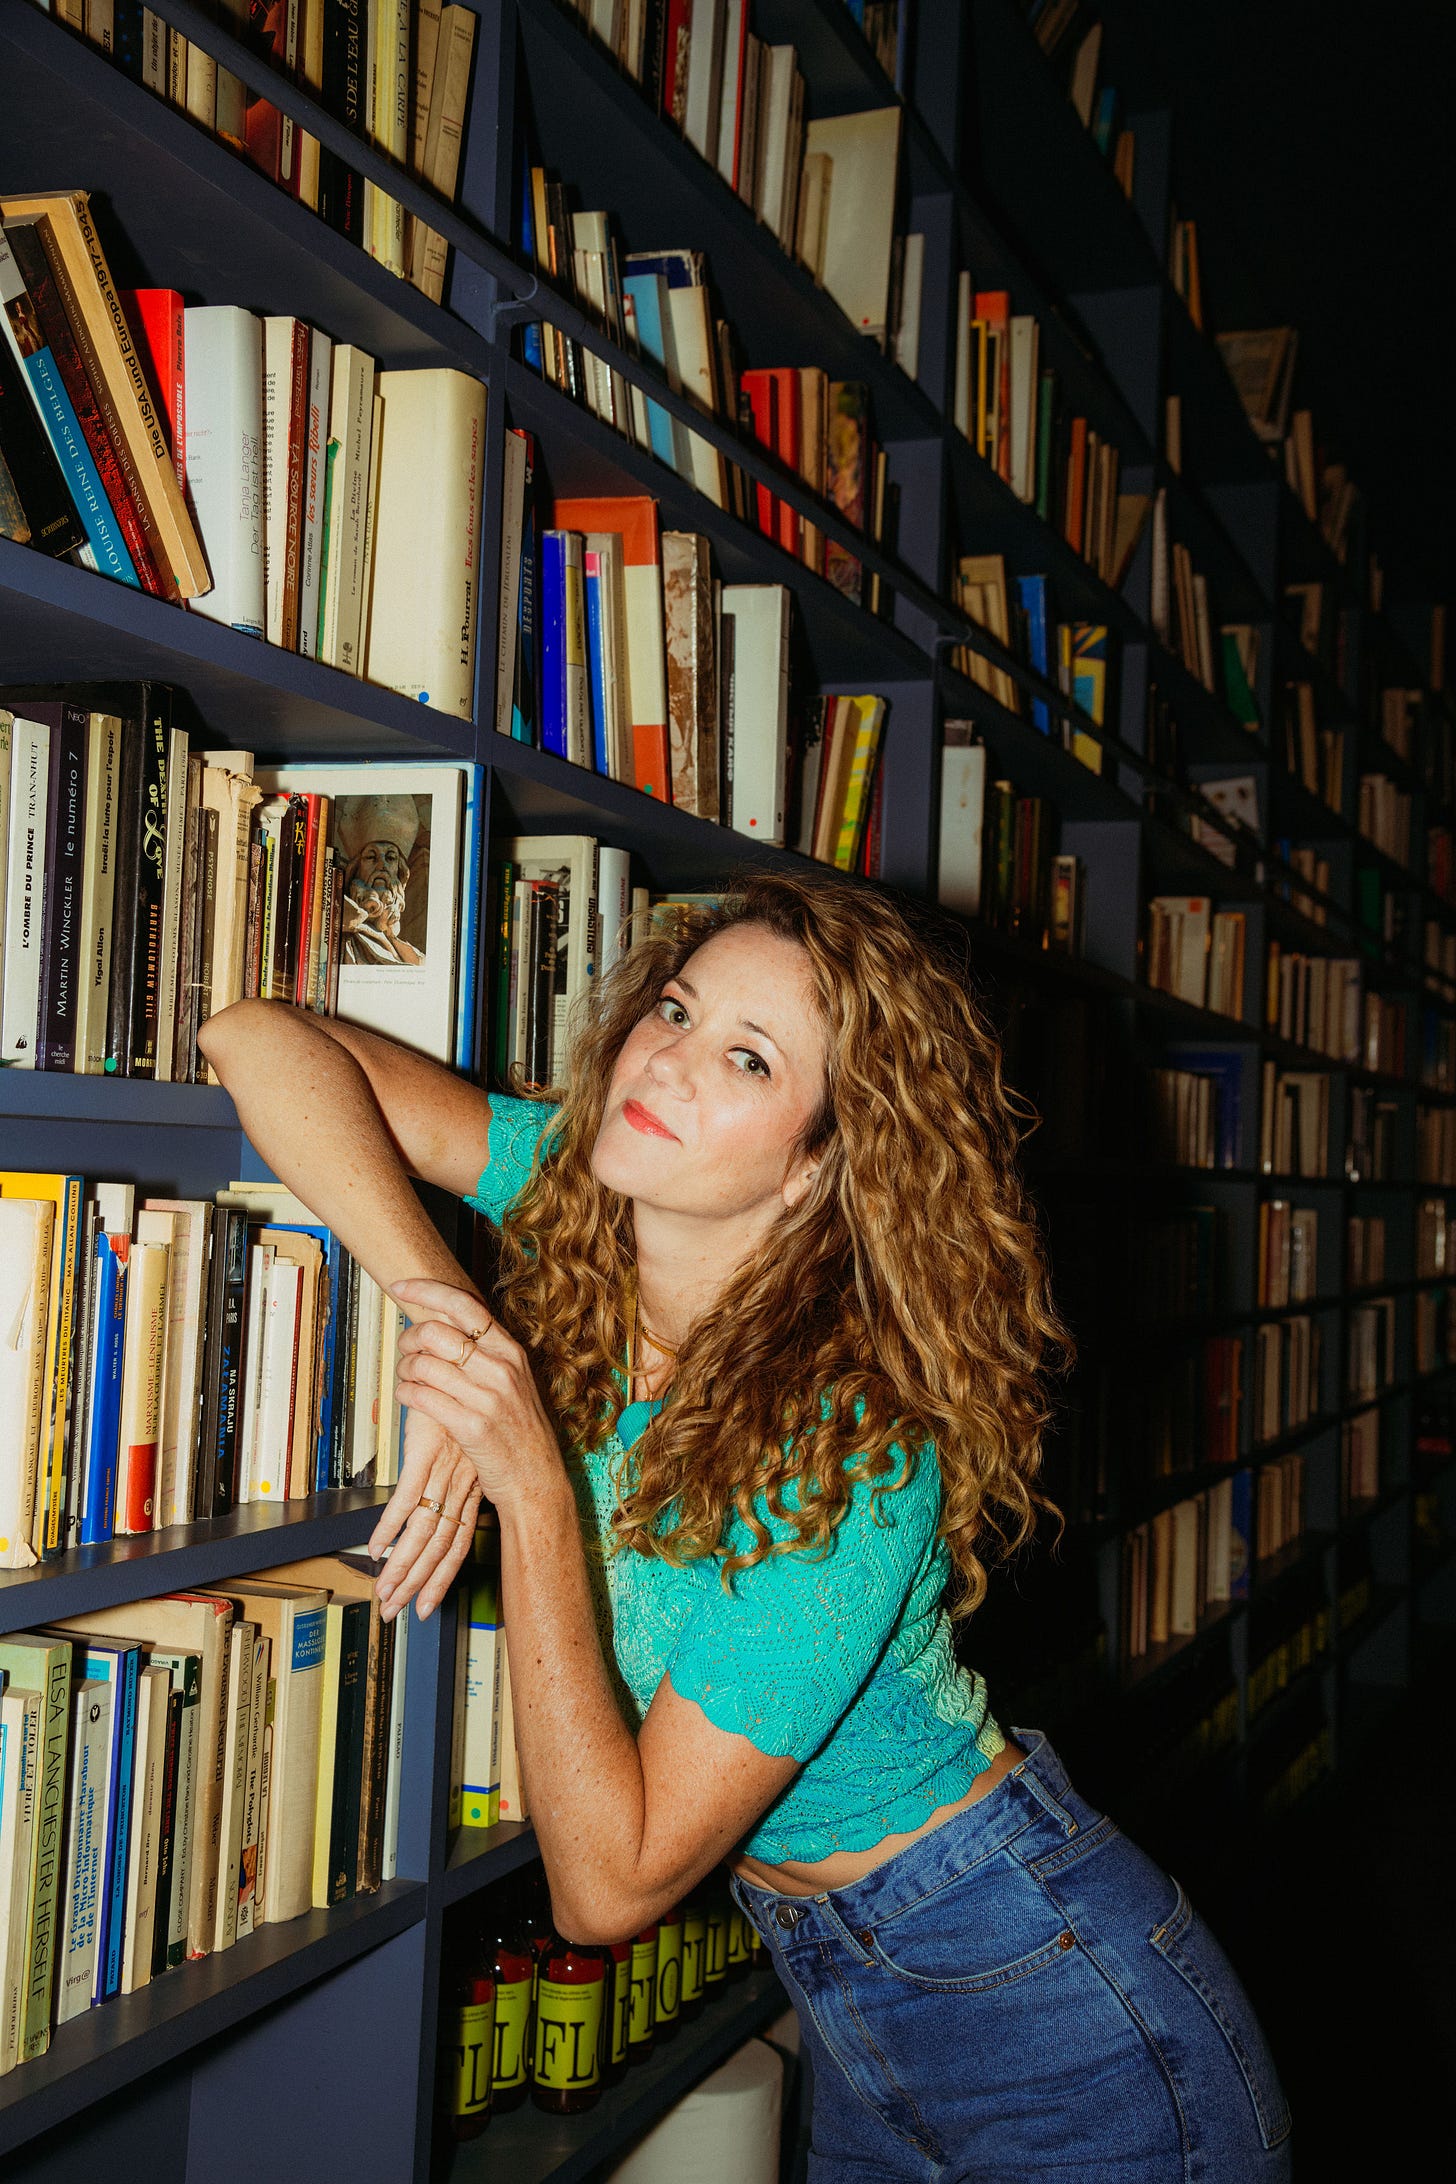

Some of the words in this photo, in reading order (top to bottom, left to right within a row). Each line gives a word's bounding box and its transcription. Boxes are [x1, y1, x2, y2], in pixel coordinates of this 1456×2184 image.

[346, 77, 358, 104] DE
[396, 73, 408, 129] CARPE
[75, 201, 110, 291] 1917-1945
[104, 290, 132, 354] Europa
[125, 354, 145, 389] und
[175, 340, 183, 372] Pierre
[36, 357, 65, 422] BELGES
[138, 388, 156, 430] USA
[61, 425, 80, 459] DES
[151, 430, 165, 459] Die
[241, 430, 251, 480] Langer
[290, 443, 300, 464] LA
[355, 429, 363, 462] Michel
[469, 417, 480, 459] sages
[119, 449, 131, 471] DES
[468, 464, 476, 484] les
[74, 460, 100, 513] REINE
[126, 476, 146, 514] DANSE
[240, 485, 250, 521] Tanja
[288, 468, 301, 535] SOURCE
[468, 486, 476, 501] et
[141, 515, 150, 532] LA
[251, 491, 264, 521] Tag
[94, 513, 123, 574] LOUISE
[251, 528, 261, 555] Der
[286, 537, 298, 593] NOIRE
[461, 580, 472, 643] Pourrat
[460, 648, 470, 667] H.
[104, 730, 114, 771] l'espoir
[153, 717, 165, 752] THE
[69, 751, 79, 761] 7
[28, 742, 40, 819] TRAN-NHUT
[105, 774, 113, 801] pour
[149, 784, 159, 807] OF
[157, 760, 168, 815] DEATH
[65, 769, 79, 835] numéro
[26, 828, 37, 870] PRINCE
[64, 843, 75, 857] le
[25, 874, 35, 891] DU
[206, 850, 215, 901] PSYCHOSE
[21, 896, 34, 949] L'OMBRE
[95, 927, 106, 957] Allon
[147, 904, 160, 988] BARTHOLOMEW
[94, 959, 105, 987] Yigal
[203, 961, 211, 997] ROBERT
[145, 994, 156, 1019] GILL
[69, 1183, 78, 1222] COLLINS
[68, 1224, 76, 1254] ALLAN
[65, 1256, 74, 1278] MAX
[63, 1288, 72, 1323] TITANIC
[62, 1325, 70, 1339] DU
[156, 1334, 163, 1347] ET
[34, 1351, 42, 1371] AUX
[60, 1340, 68, 1386] MEURTRES
[154, 1352, 162, 1394] GUERRE
[229, 1369, 237, 1386] NA
[58, 1388, 66, 1403] LES
[145, 1376, 155, 1435] MARXISME
[153, 1396, 160, 1410] LA
[226, 1389, 236, 1433] SKRAJU
[223, 1616, 232, 1648] The
[49, 1662, 68, 1724] ELSA
[219, 1652, 230, 1715] Evasive
[254, 1672, 263, 1710] William
[28, 1710, 38, 1755] VOLER
[216, 1720, 226, 1782] Neutral
[251, 1711, 261, 1759] Gerhardie
[18, 1744, 28, 1792] jacqueline
[26, 1760, 34, 1778] ET
[79, 1744, 91, 1806] Marabout
[250, 1767, 258, 1790] The
[23, 1783, 33, 1824] VIVRE
[40, 1734, 63, 1893] LANCHESTER
[246, 1792, 256, 1845] Polyglots
[82, 1786, 96, 1874] Informatique
[73, 1810, 87, 1890] Dictionnaire
[79, 1875, 90, 1911] Micro
[87, 1846, 99, 1908] l'Internet
[71, 1893, 81, 1934] Grand
[78, 1916, 87, 1928] la
[86, 1912, 95, 1927] de
[32, 1897, 53, 1999] HERSELF
[69, 1938, 78, 1953] Le
[77, 1932, 86, 1948] de
[86, 1932, 94, 1945] et
[9, 1986, 18, 2050] FLAMMARION
[536, 2016, 597, 2083] FL
